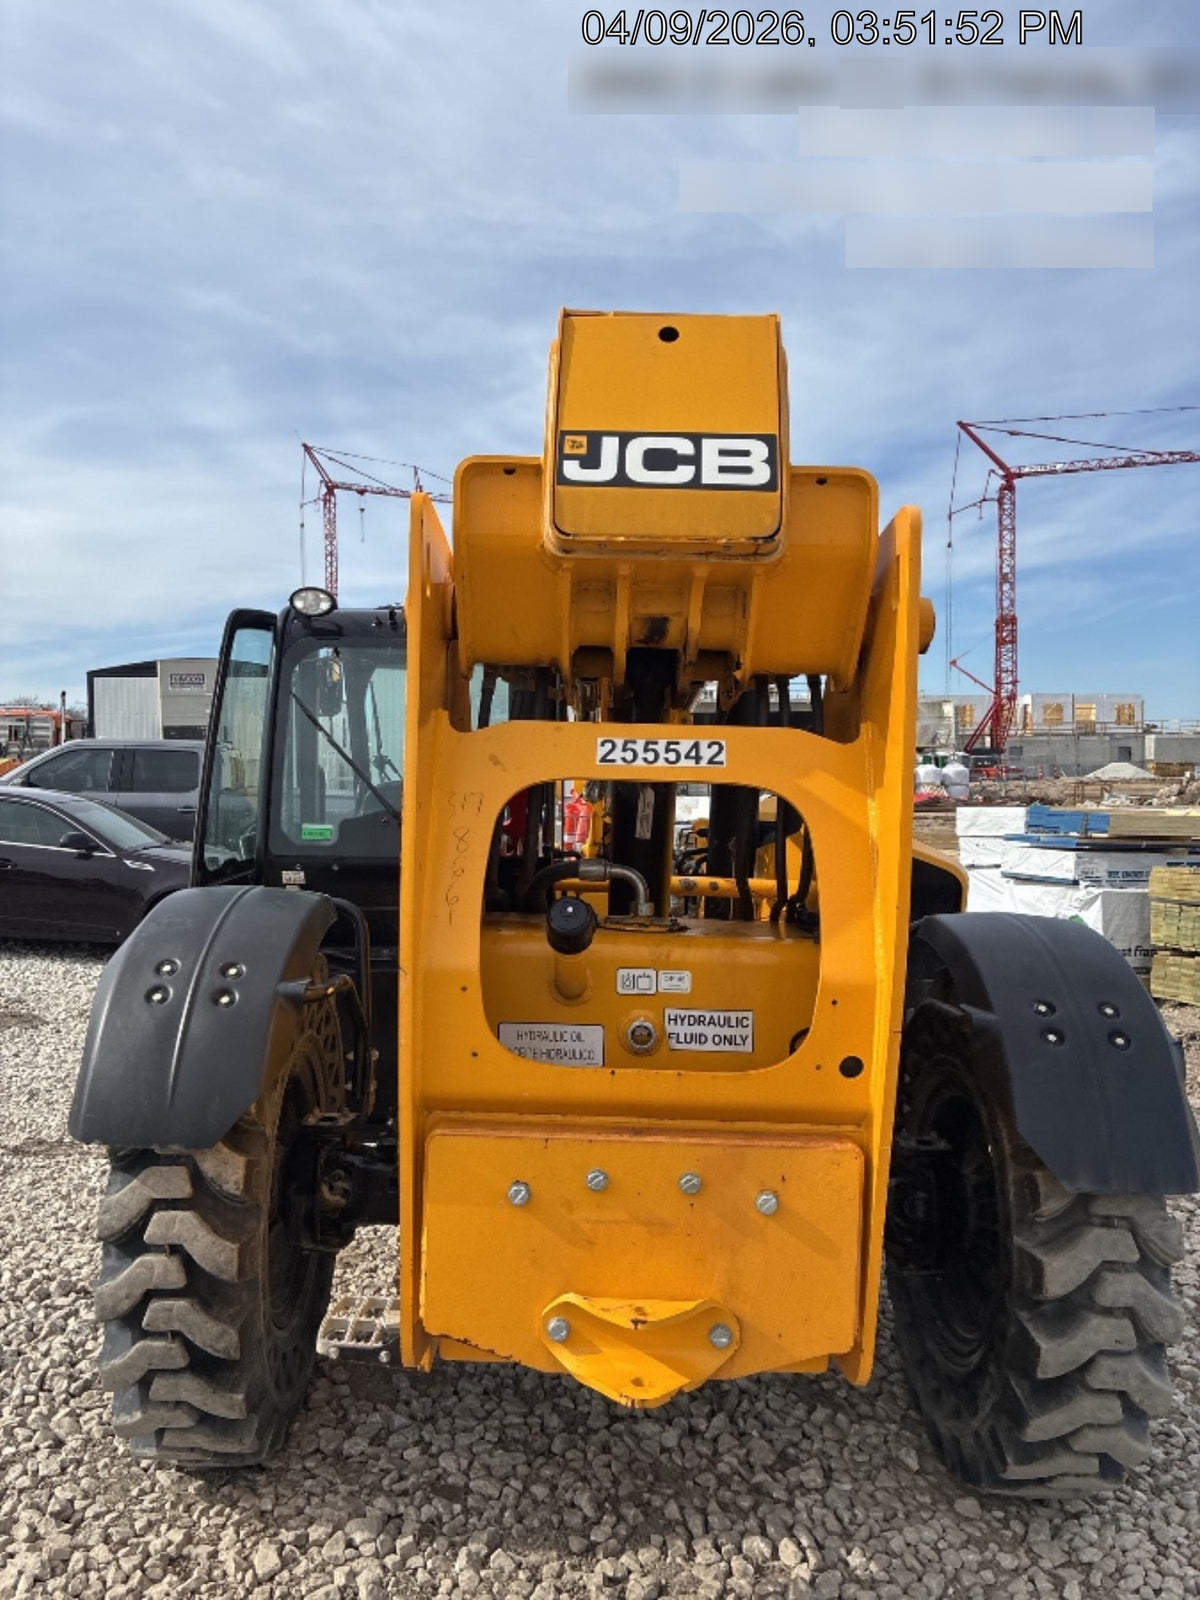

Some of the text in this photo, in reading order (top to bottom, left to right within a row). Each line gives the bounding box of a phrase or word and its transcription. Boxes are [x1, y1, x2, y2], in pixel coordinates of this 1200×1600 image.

[563, 435, 771, 486] JCB
[598, 739, 725, 765] 255542
[667, 1013, 750, 1029] HYDRAULIC
[668, 1032, 749, 1047] FLUID ONLY
